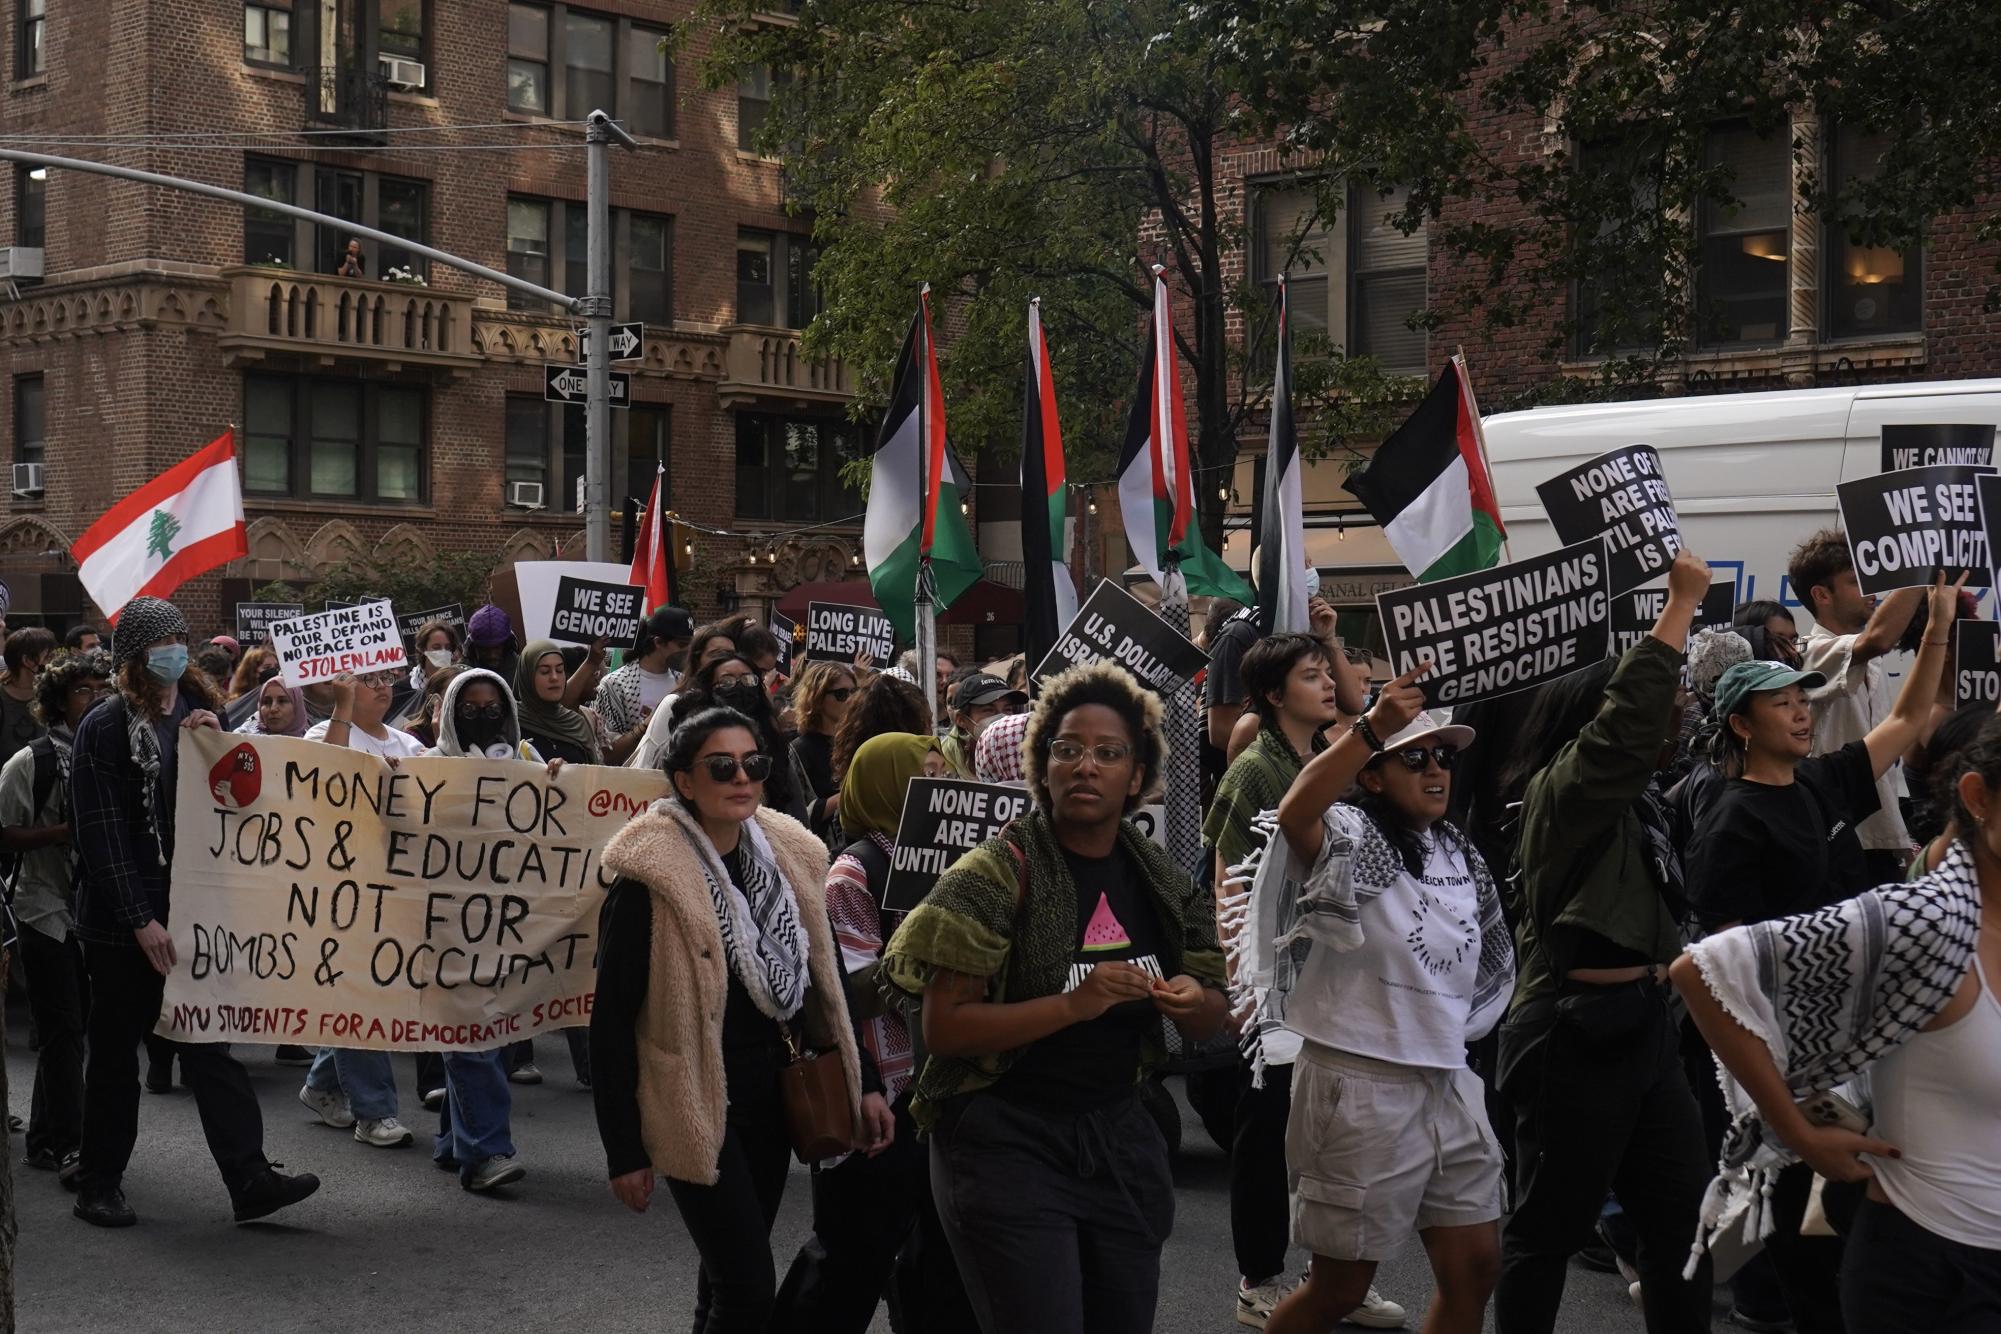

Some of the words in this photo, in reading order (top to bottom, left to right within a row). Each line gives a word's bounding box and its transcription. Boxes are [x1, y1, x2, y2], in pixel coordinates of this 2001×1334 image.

[613, 336, 632, 350] WAY
[560, 377, 582, 392] ONE
[1893, 448, 1919, 470] WE
[1924, 447, 1976, 465] CANNOT
[1570, 456, 1636, 502] NONE
[1632, 452, 1653, 475] OF
[1600, 484, 1647, 523] ARE
[1883, 486, 1932, 526] WE
[1935, 484, 1975, 522] SEE
[1598, 522, 1642, 554] TIL
[1634, 544, 1662, 572] IS
[574, 588, 602, 612] WE
[605, 592, 634, 614] SEE
[1319, 584, 1366, 598] SANAL
[1393, 553, 1599, 641] PALESTINIANS
[240, 608, 264, 618] YOUR
[264, 608, 301, 618] SILENCE
[274, 610, 360, 637] PALESTINE
[368, 606, 384, 618] IS
[408, 616, 426, 626] YOUR
[1633, 592, 1664, 621] WE
[240, 630, 251, 640] BE
[292, 632, 323, 648] OUR
[331, 618, 392, 638] DEMAND
[555, 610, 638, 639] GENOCIDE
[810, 610, 854, 632] LONG
[858, 614, 892, 639] LIVE
[1400, 640, 1457, 684] ARE
[1463, 590, 1607, 667] RESISTING
[284, 648, 302, 662] NO
[307, 638, 354, 658] PEACE
[360, 632, 386, 646] ON
[808, 630, 889, 660] PALESTINE
[1057, 633, 1100, 667] ISRA
[1084, 612, 1116, 650] U.S.
[1114, 636, 1174, 688] DOLLARS
[1438, 638, 1577, 702] GENOCIDE
[1959, 670, 2000, 701] STO
[238, 752, 254, 762] NYU
[286, 762, 446, 824] MONEY
[472, 776, 566, 836] FOR
[929, 788, 988, 818] NONE
[994, 796, 1024, 822] OF
[210, 808, 315, 870] JOBS
[327, 820, 356, 871] &
[933, 818, 980, 848] ARE
[894, 846, 950, 875] UNTIL
[1420, 874, 1445, 886] BEACH
[1445, 874, 1471, 886] TOWN
[288, 880, 397, 932] NOT
[426, 892, 530, 946] FOR
[192, 923, 298, 980] BOMBS
[314, 937, 344, 987] &
[172, 1004, 210, 1035] NYU
[217, 1005, 308, 1036] STUDENTS
[320, 1012, 364, 1040] FOR
[366, 1018, 386, 1040] A
[392, 1014, 522, 1044] DEMOCRATIC
[532, 992, 594, 1027] SOCIE
